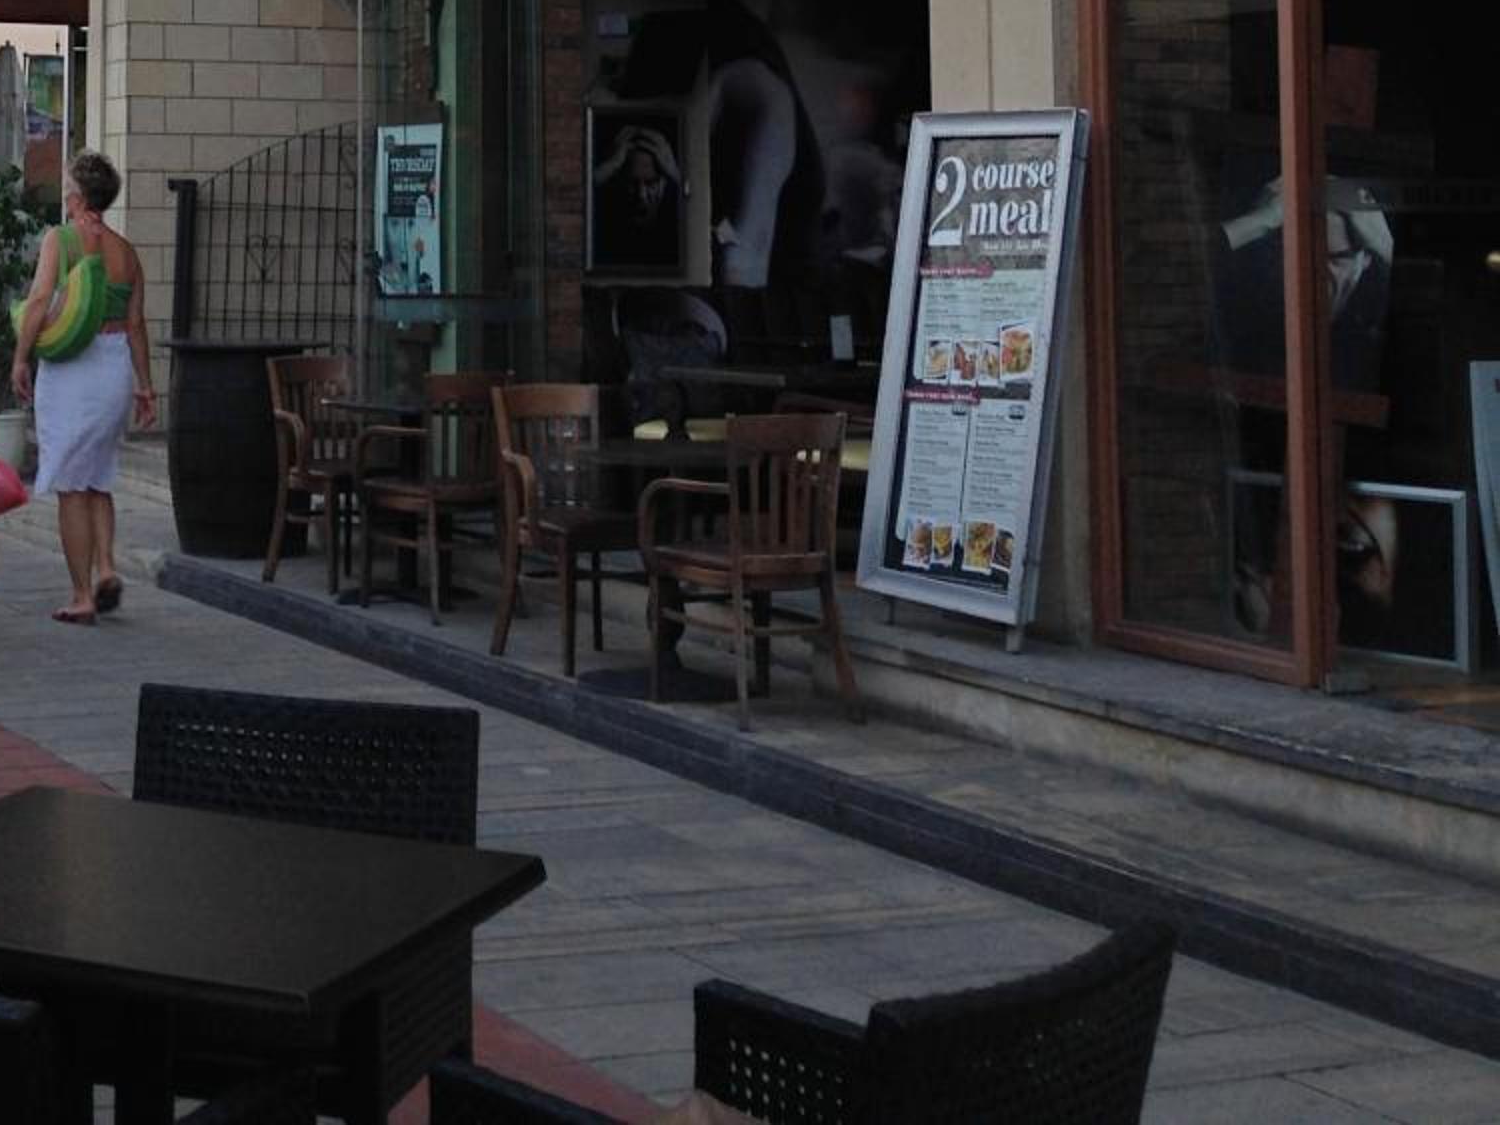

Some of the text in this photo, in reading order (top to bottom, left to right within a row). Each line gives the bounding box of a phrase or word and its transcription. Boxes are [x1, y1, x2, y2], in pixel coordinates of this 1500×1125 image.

[927, 156, 1055, 247] 2 course
[968, 188, 1053, 237] meal
